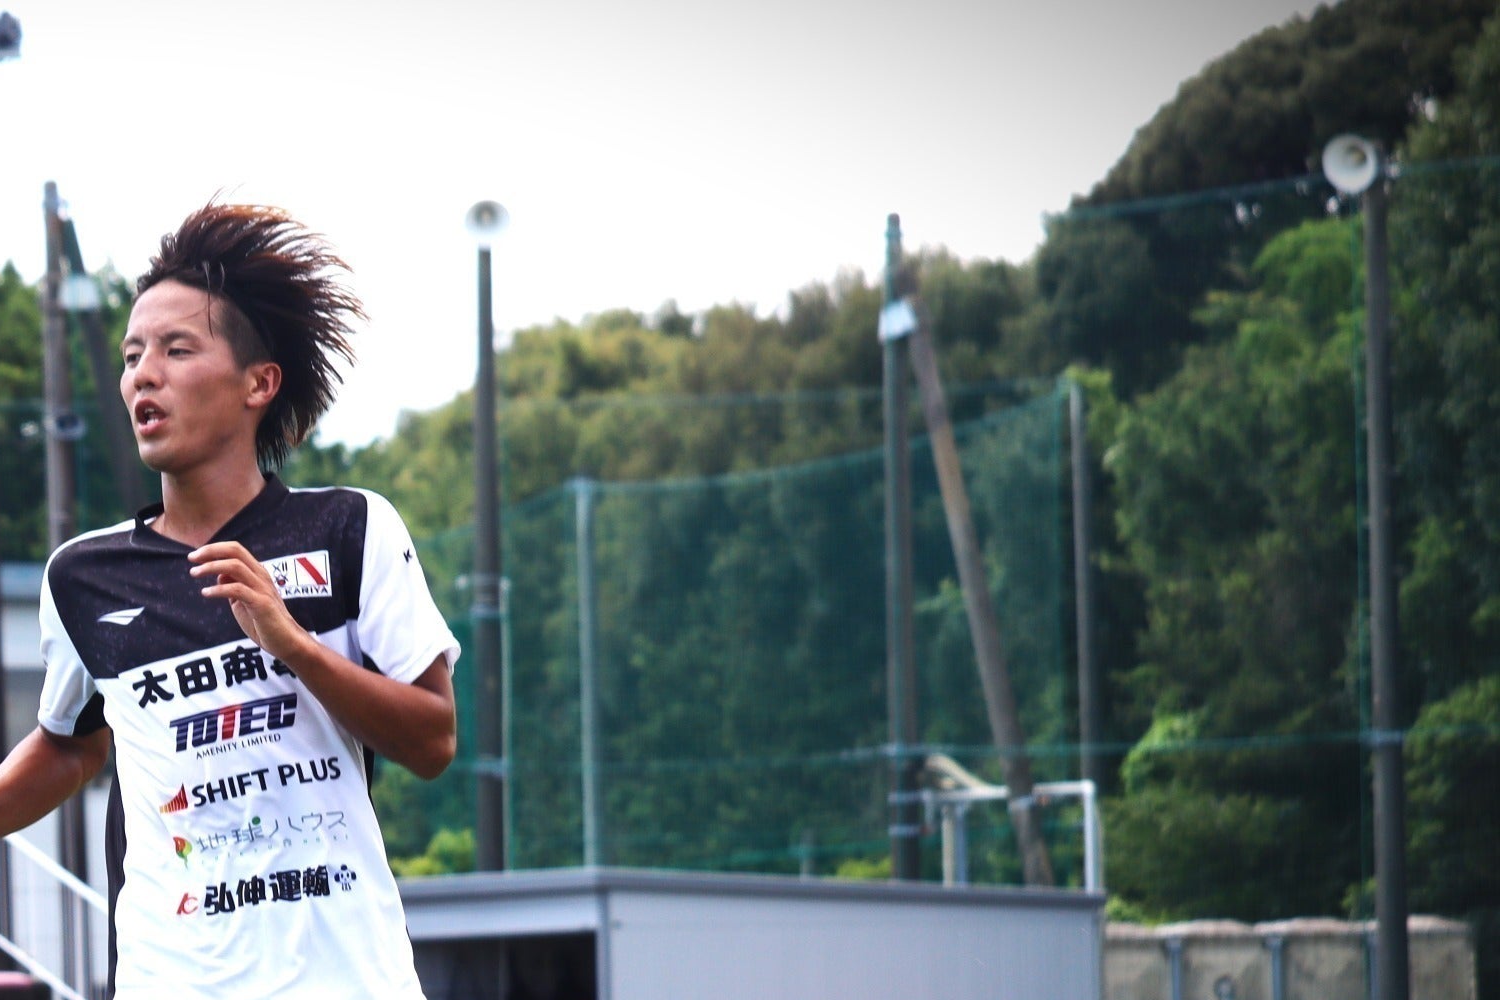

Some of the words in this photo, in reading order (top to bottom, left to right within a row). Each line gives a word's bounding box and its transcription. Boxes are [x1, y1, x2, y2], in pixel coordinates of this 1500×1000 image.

[169, 692, 298, 753] TOTEC
[196, 742, 238, 760] AMENITY
[241, 733, 281, 749] LIMITED
[191, 767, 269, 808] SHIFT
[277, 757, 342, 787] PLUS
[204, 865, 330, 916] 弘伸運輸
